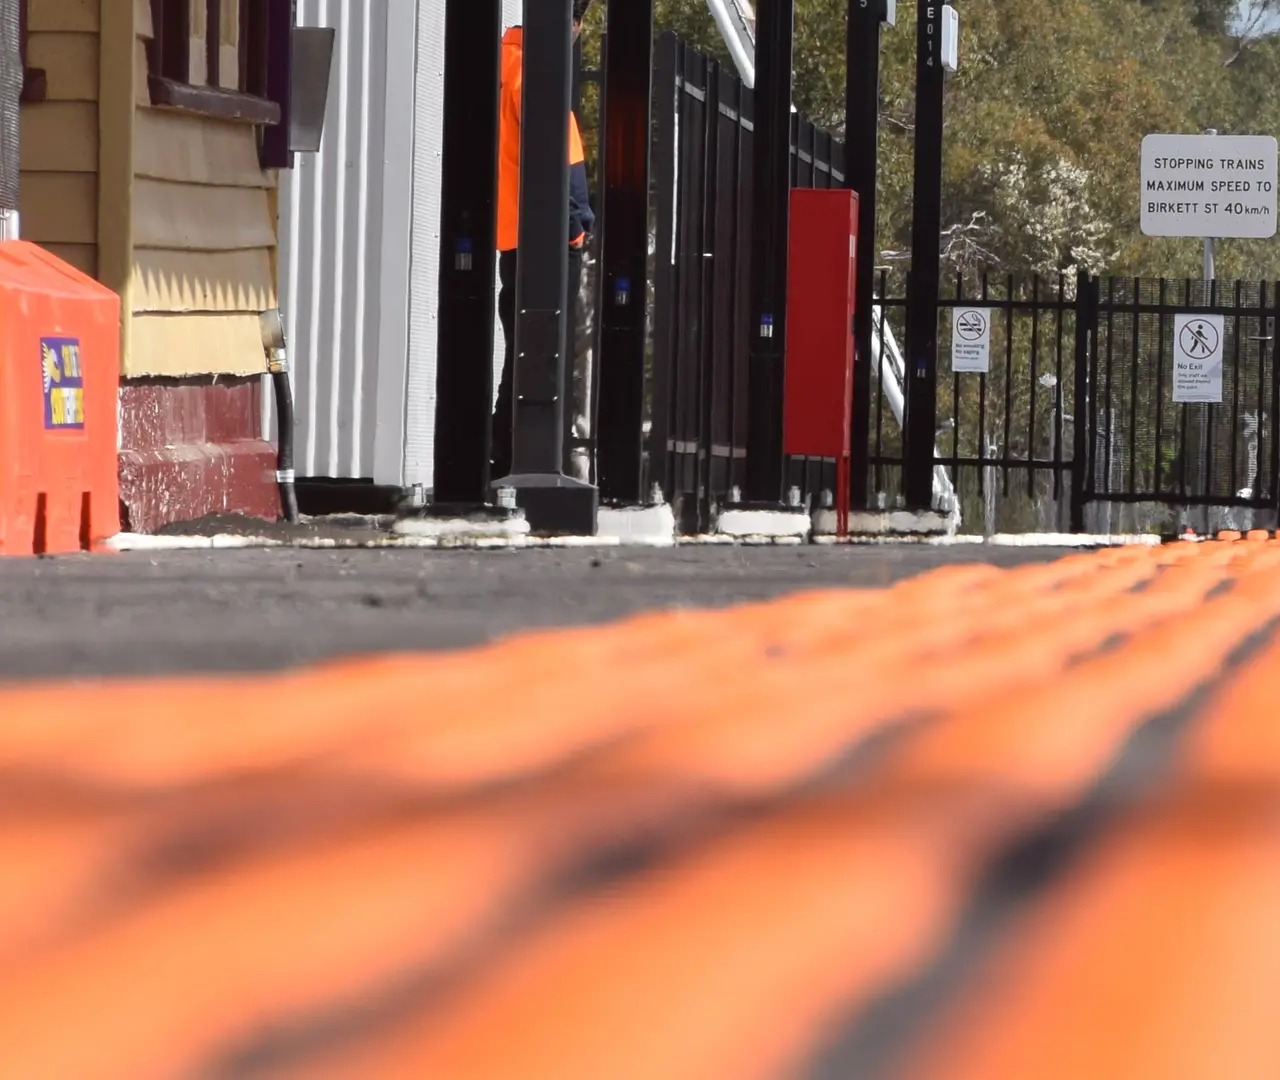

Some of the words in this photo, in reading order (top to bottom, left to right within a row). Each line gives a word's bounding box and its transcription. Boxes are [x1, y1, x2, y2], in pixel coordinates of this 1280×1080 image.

[1153, 157, 1214, 170] STOPPING
[1219, 158, 1265, 171] TRAINS
[1146, 179, 1205, 192] MAXIMUM
[1210, 180, 1251, 192] SPEED
[1256, 180, 1272, 193] TO
[1147, 201, 1199, 214] BIRKETT
[1204, 202, 1219, 214] ST
